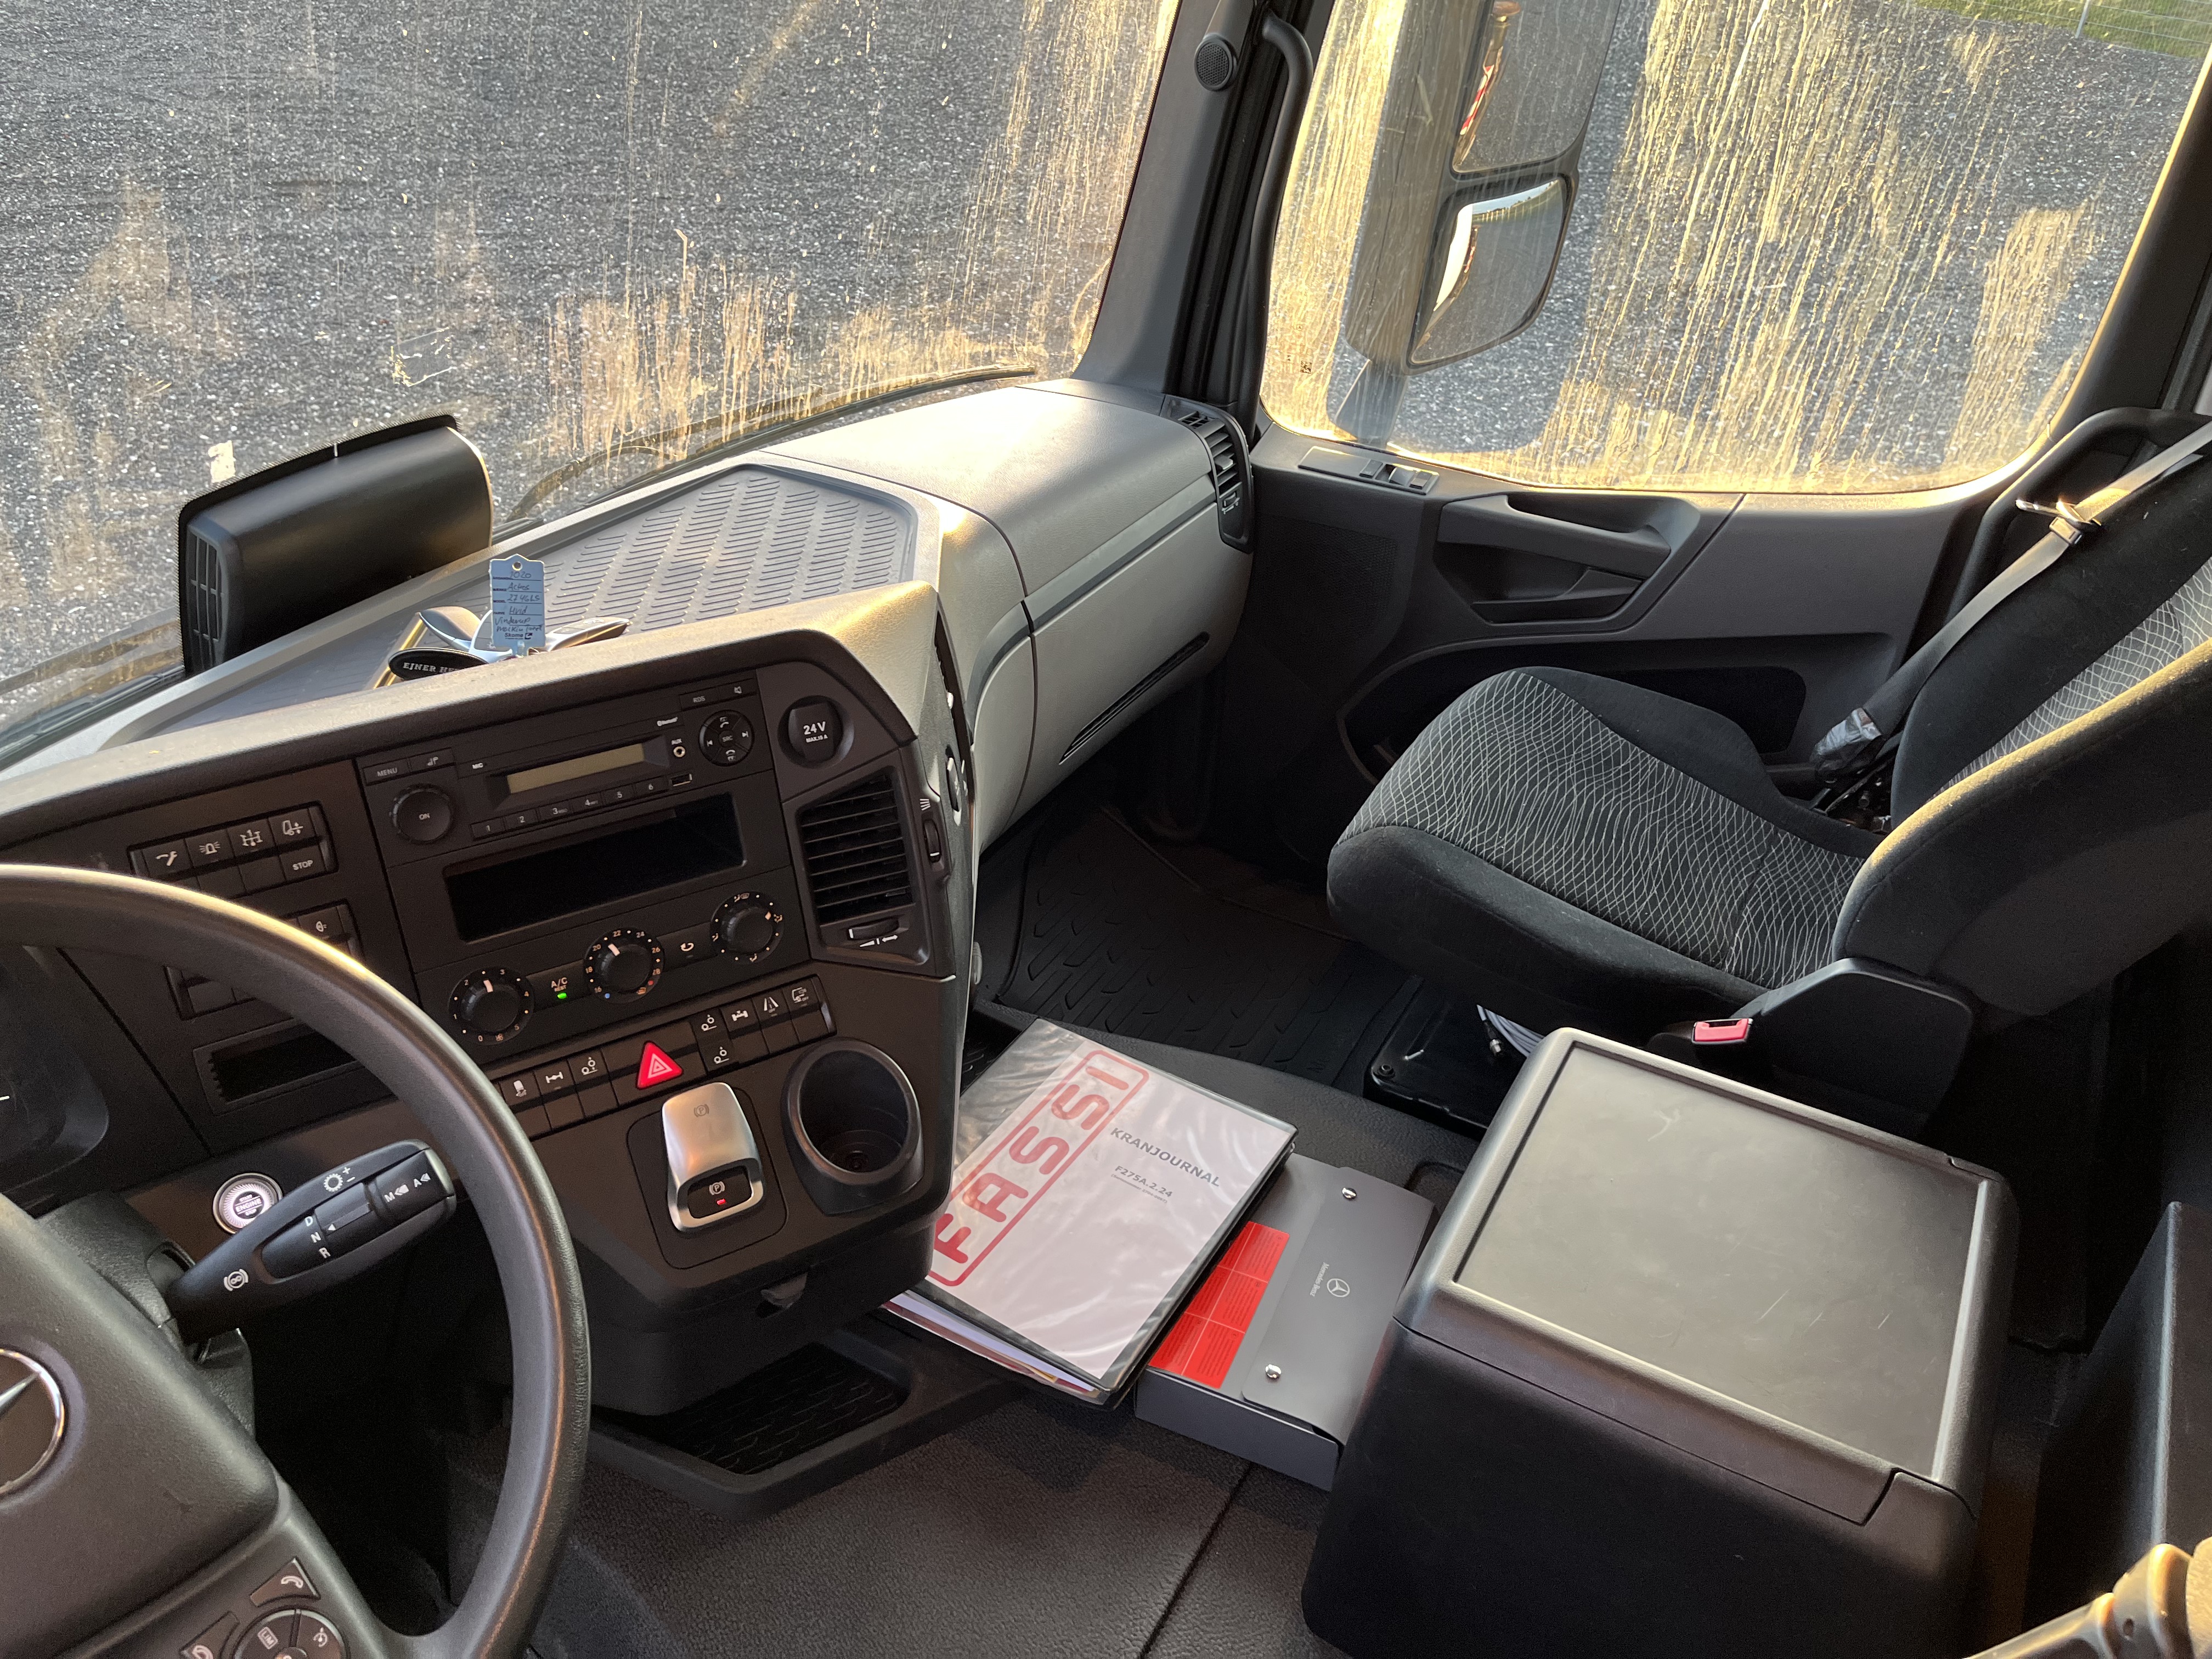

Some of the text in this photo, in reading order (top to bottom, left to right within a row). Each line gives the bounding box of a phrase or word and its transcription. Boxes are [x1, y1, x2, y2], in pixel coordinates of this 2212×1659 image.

[403, 662, 436, 672] EJNER
[377, 768, 398, 777] MENU
[292, 860, 313, 871] STOP
[592, 944, 601, 952] 20
[551, 977, 568, 989] A/C
[1110, 1127, 1220, 1187] KRANJOURNAL
[933, 1066, 1130, 1264] FASSI
[414, 1178, 422, 1188] A
[1115, 1165, 1173, 1197] F275A.2.24
[384, 1192, 395, 1202] M
[235, 1198, 262, 1212] ENGINE
[304, 1216, 313, 1227] D
[311, 1232, 321, 1243] N
[319, 1247, 331, 1259] R
[261, 1630, 274, 1646] LIM
